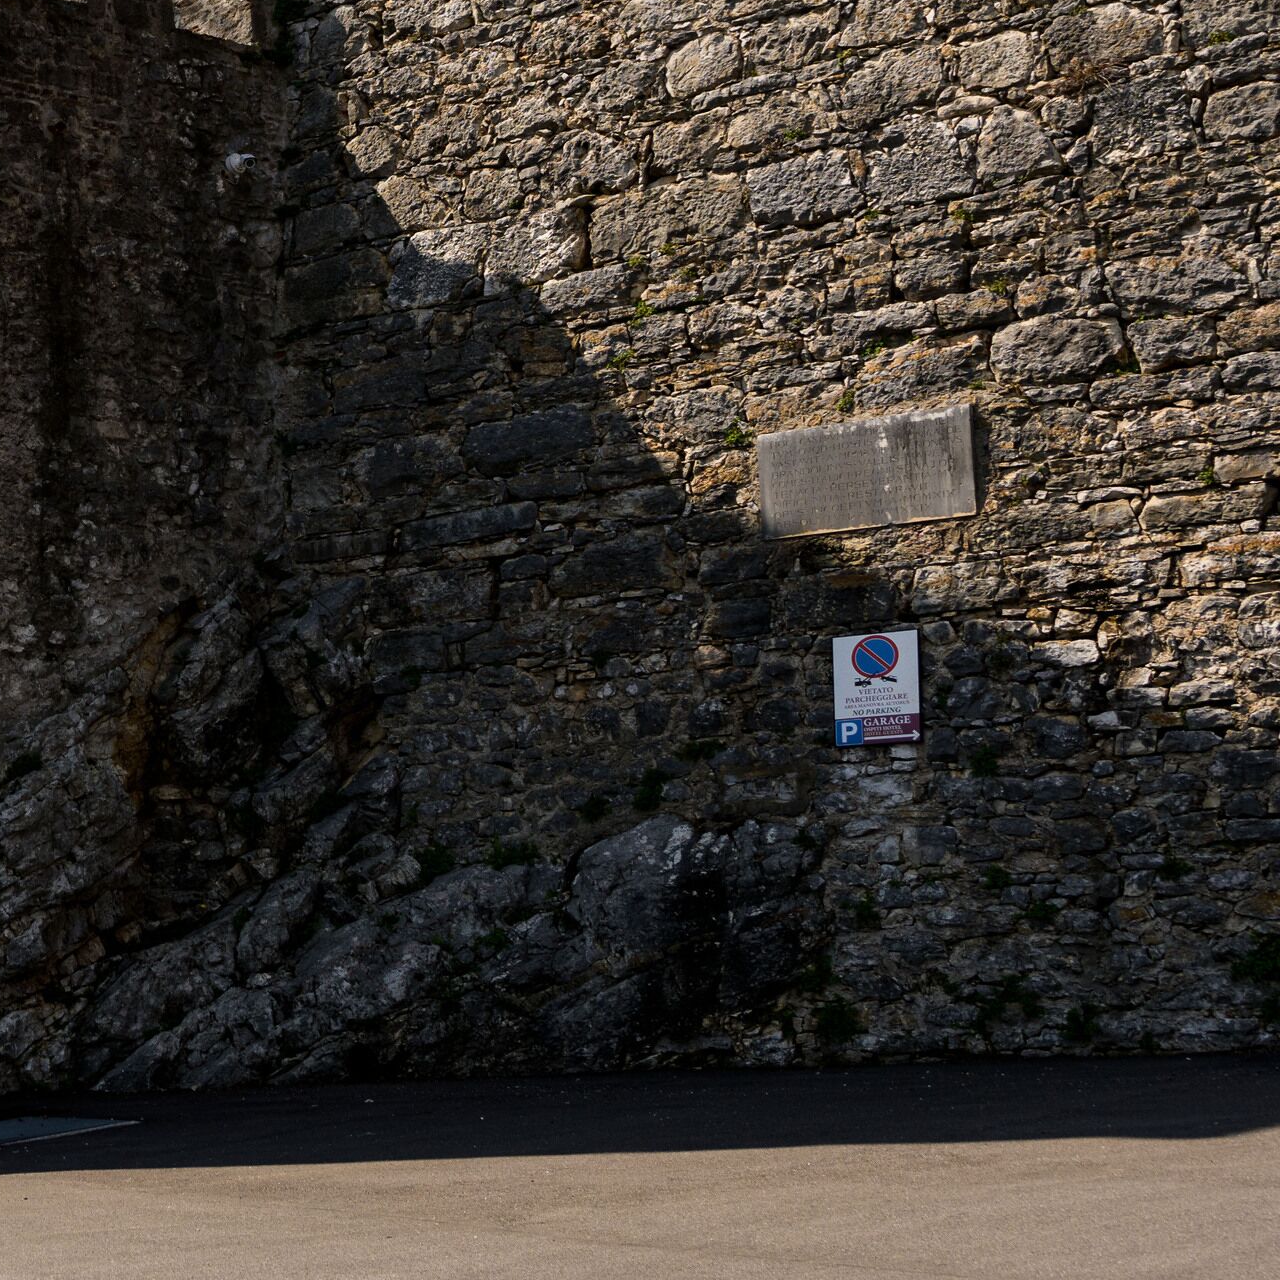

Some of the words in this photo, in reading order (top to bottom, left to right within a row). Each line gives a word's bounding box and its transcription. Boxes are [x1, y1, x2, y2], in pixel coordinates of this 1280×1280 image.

[858, 686, 894, 696] VIETATO
[845, 693, 908, 704] PARCHEGGIARE
[852, 708, 864, 716] NO
[865, 706, 901, 716] PARKING
[863, 715, 911, 727] GARAGE
[841, 722, 858, 743] P
